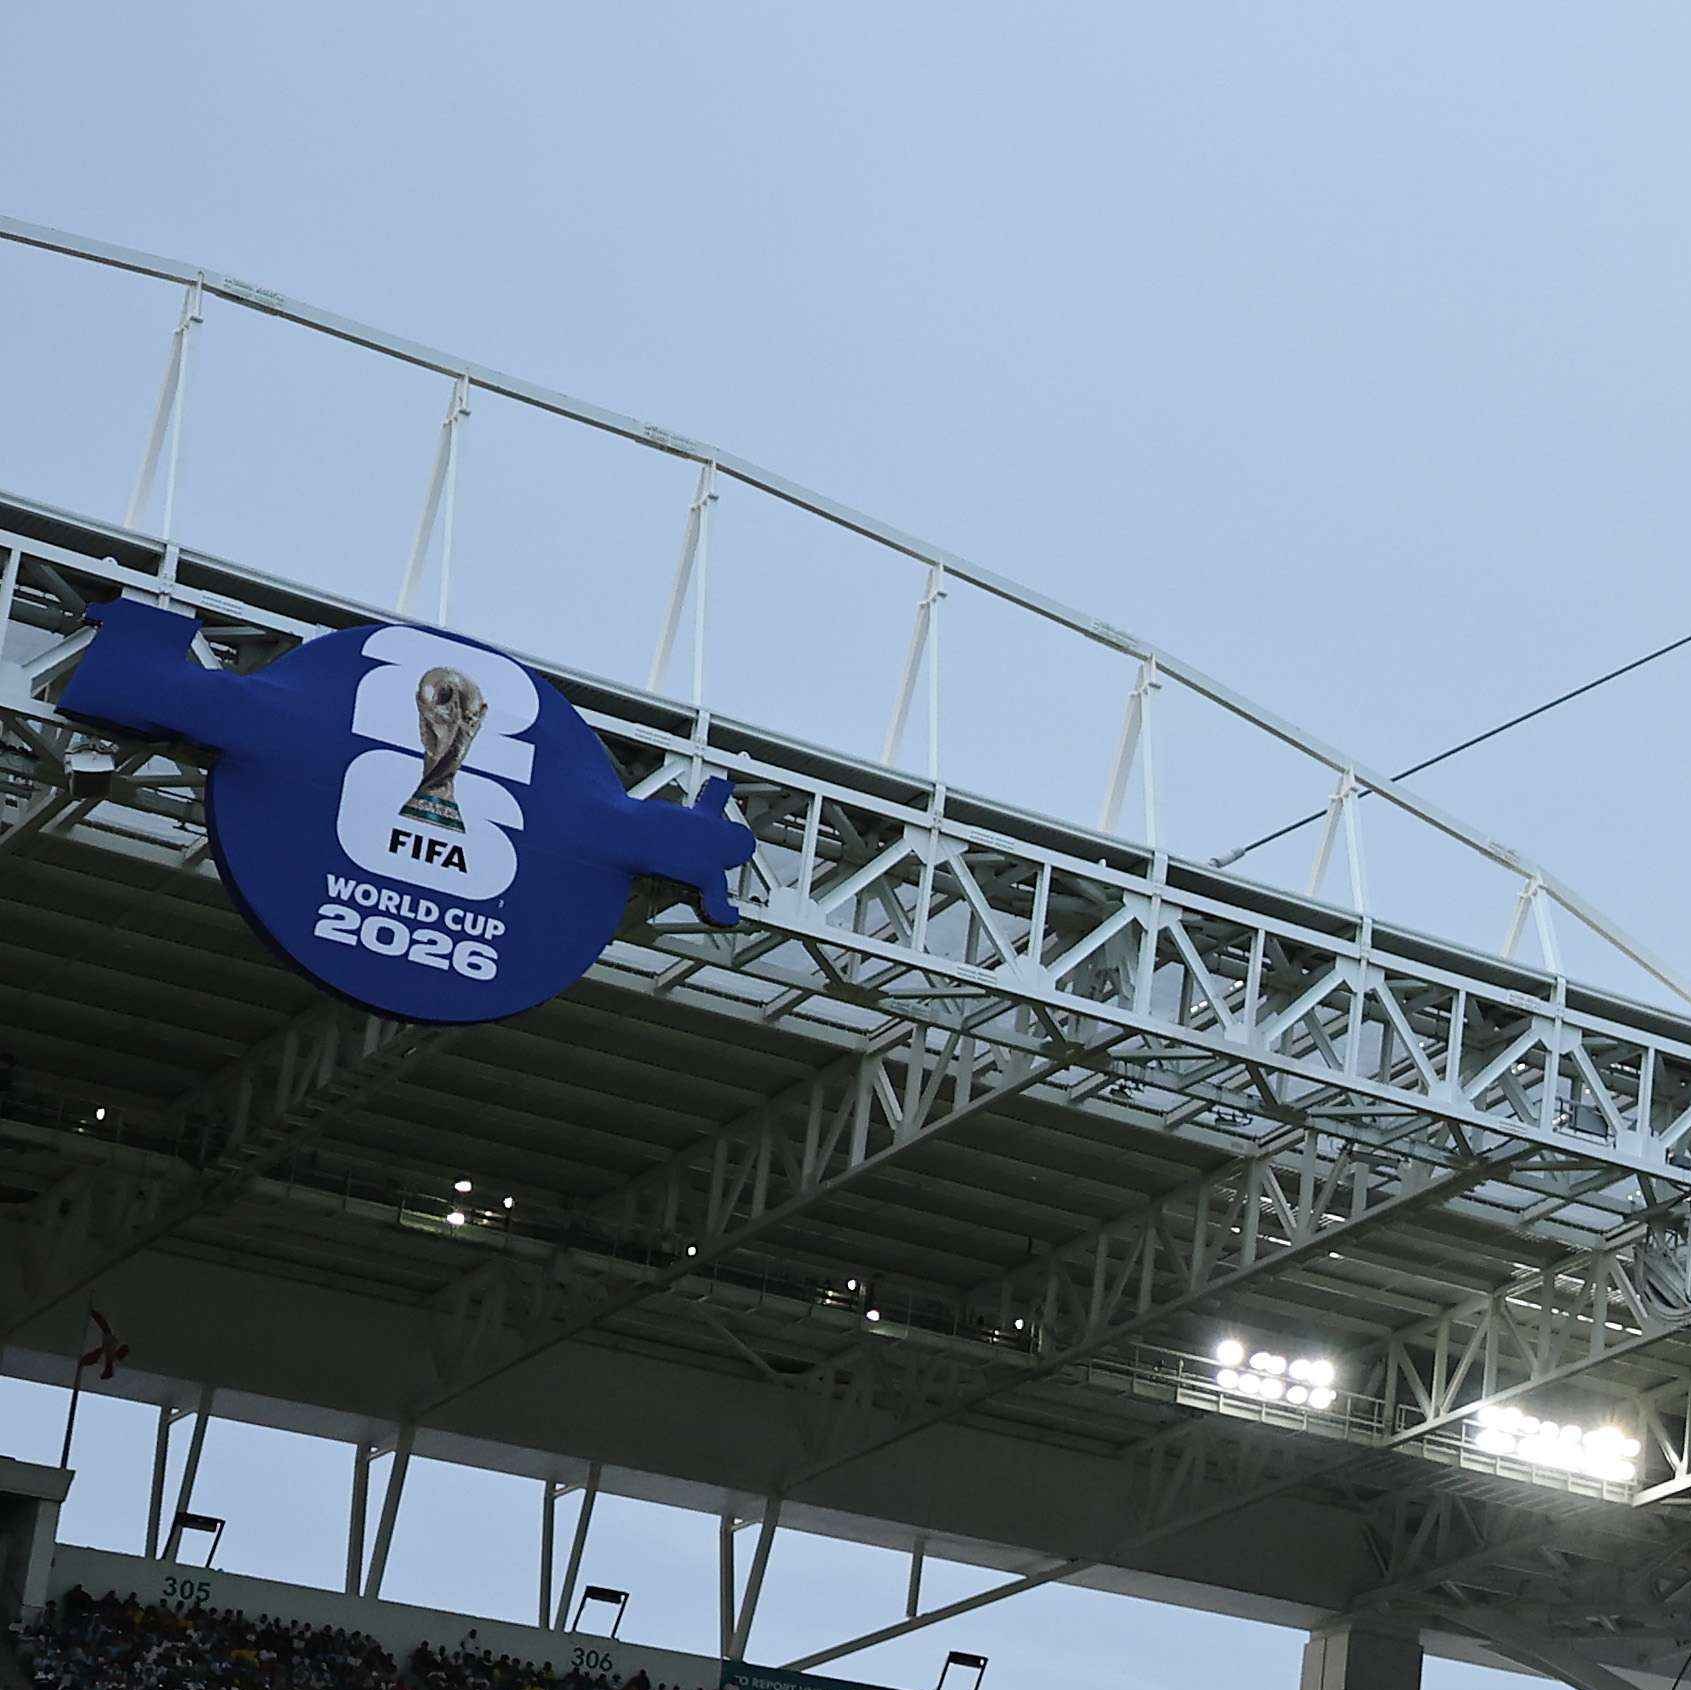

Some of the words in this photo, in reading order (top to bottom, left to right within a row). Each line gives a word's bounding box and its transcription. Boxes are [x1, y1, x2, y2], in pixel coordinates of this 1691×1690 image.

[389, 828, 468, 873] FIFA
[326, 873, 438, 925] WORLD
[444, 910, 507, 942] CUP
[313, 903, 499, 981] 2026
[163, 1576, 211, 1603] 305
[572, 1647, 613, 1672] 306
